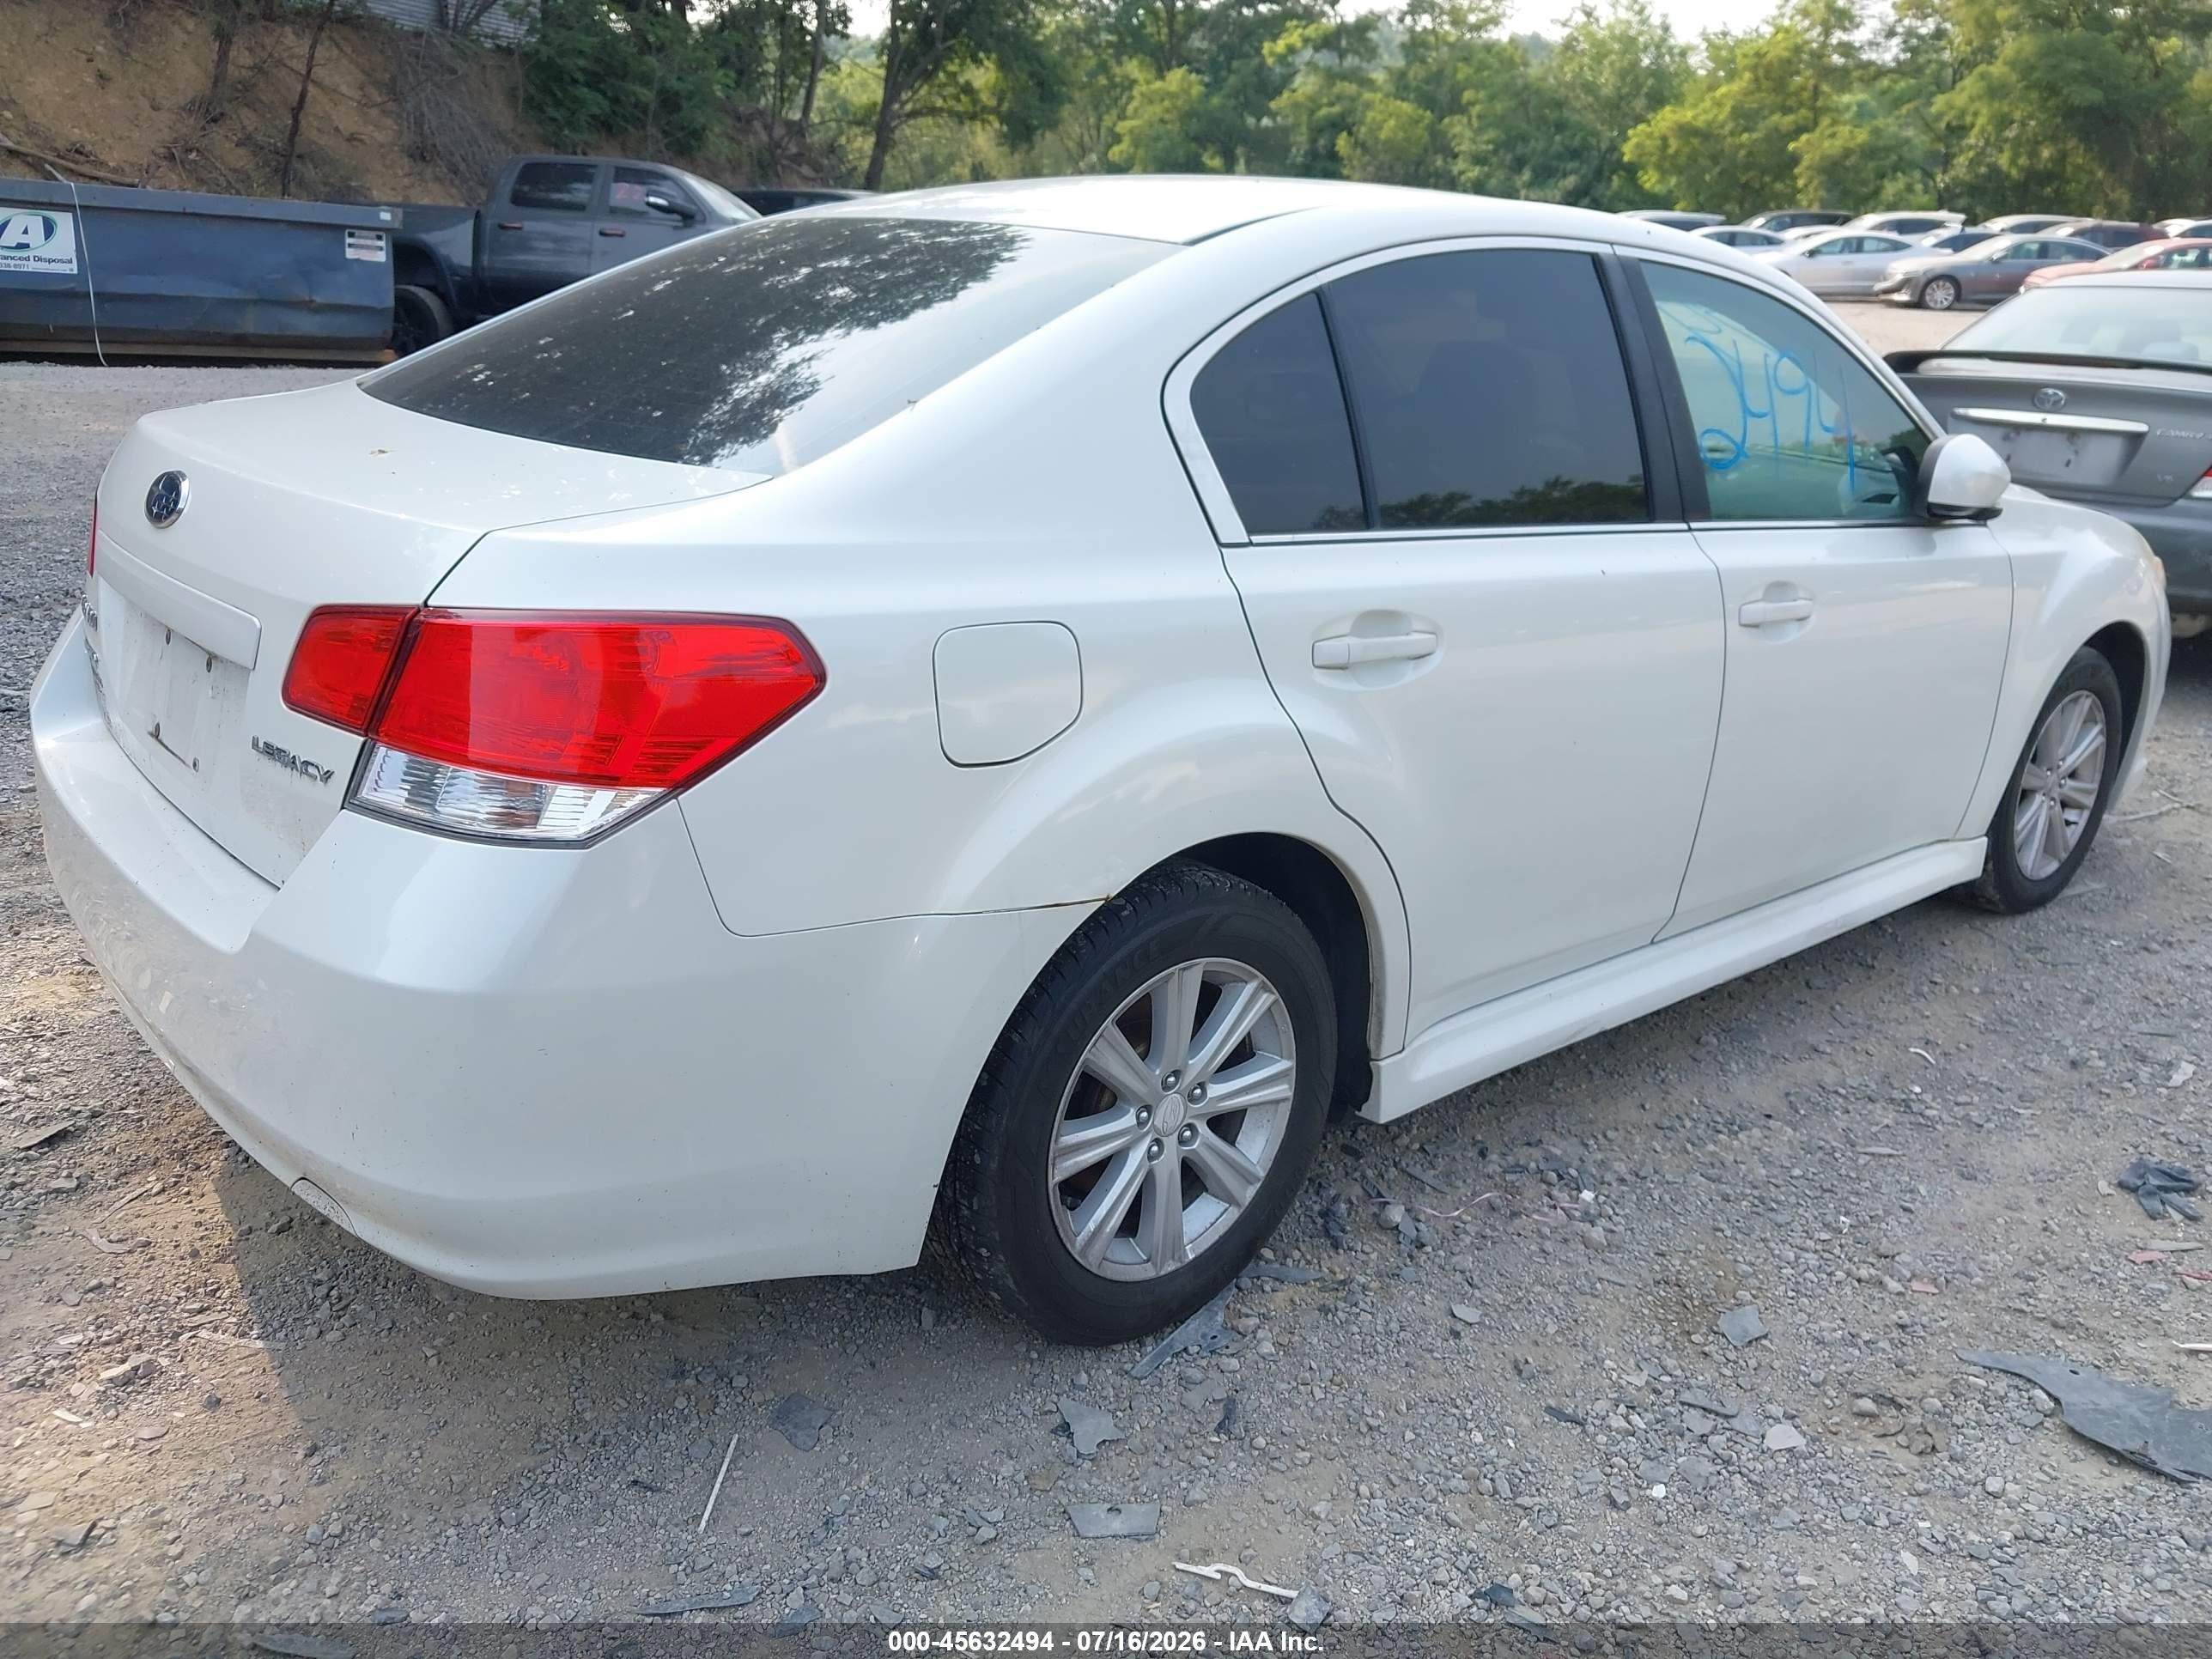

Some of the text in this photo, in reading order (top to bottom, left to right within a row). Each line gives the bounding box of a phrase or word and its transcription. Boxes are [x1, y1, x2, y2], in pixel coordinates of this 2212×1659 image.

[0, 216, 46, 248] A
[33, 255, 73, 265] Disposal
[252, 735, 336, 783] LEGACY
